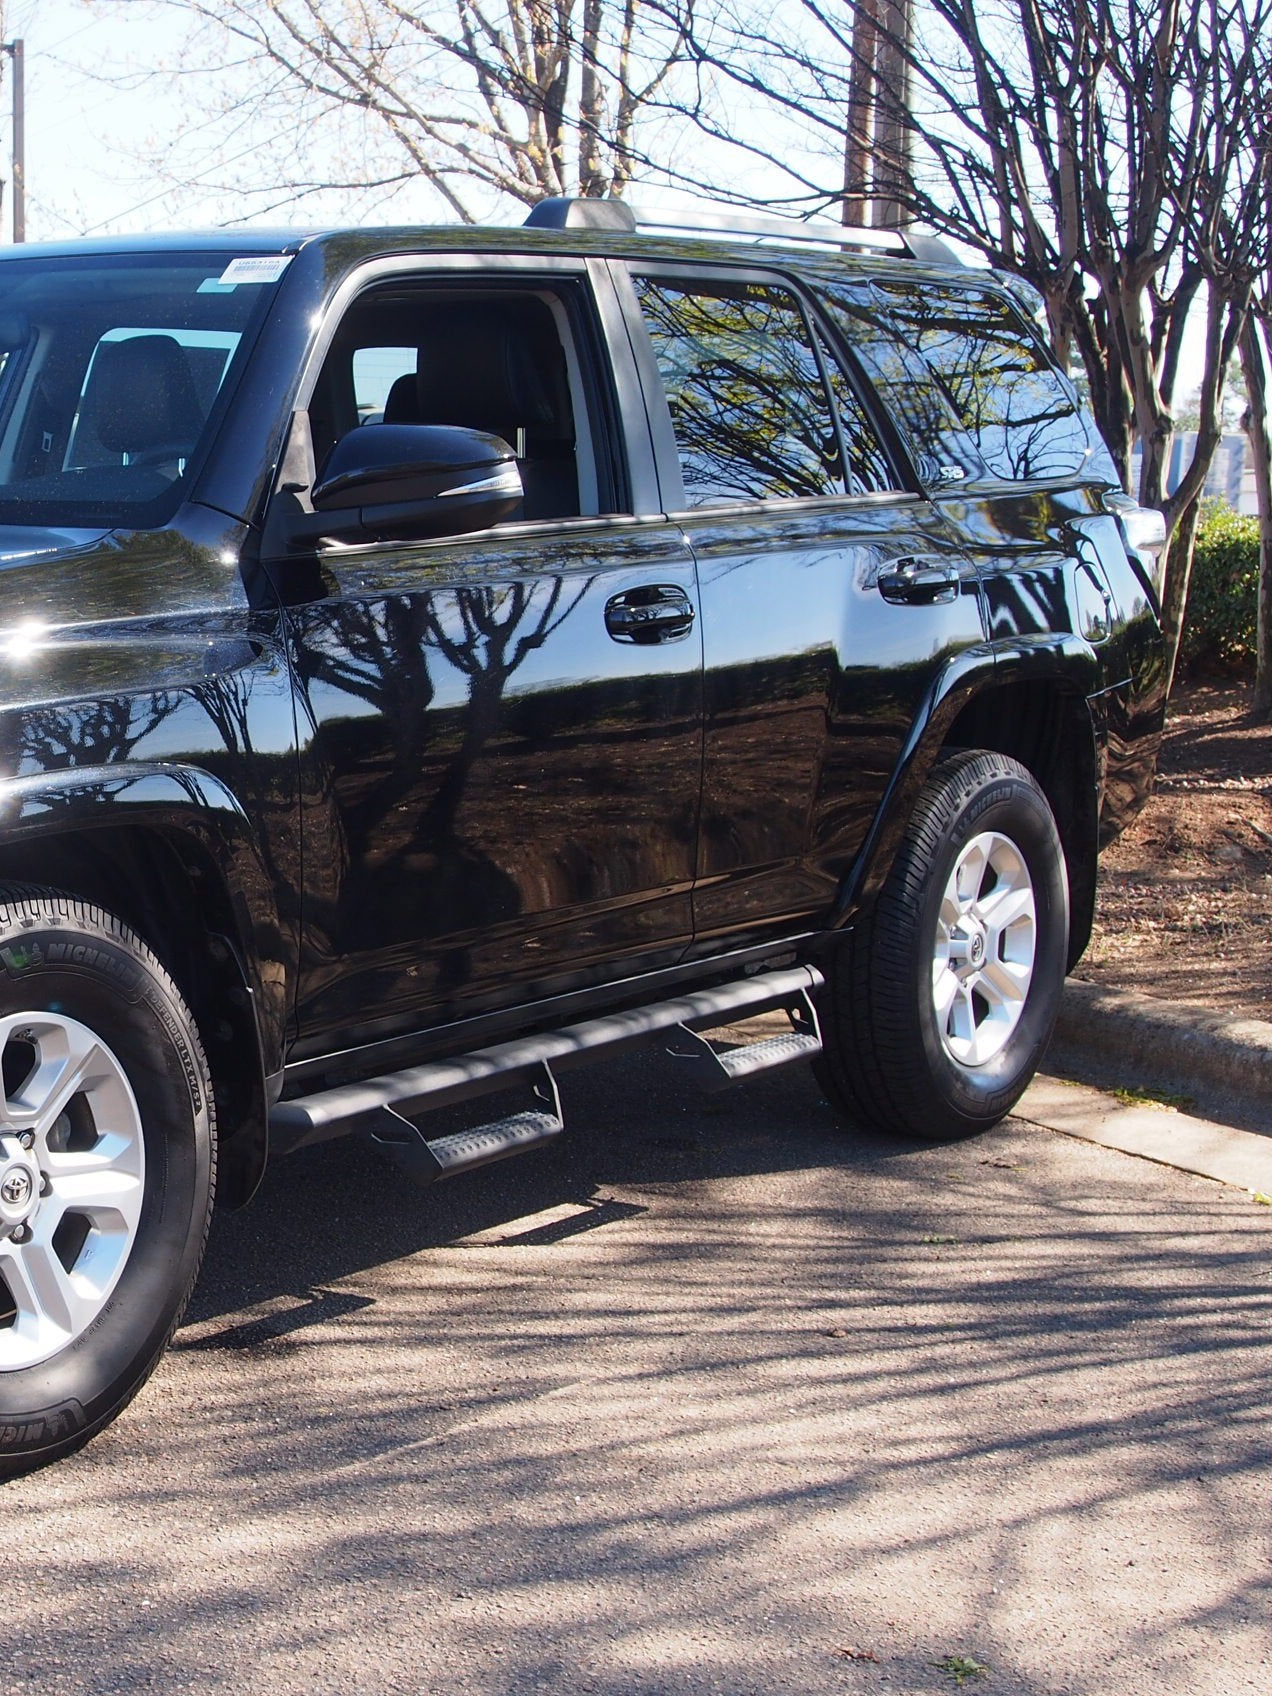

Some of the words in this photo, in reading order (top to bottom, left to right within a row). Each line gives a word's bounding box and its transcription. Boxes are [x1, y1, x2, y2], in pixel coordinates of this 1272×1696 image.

[47, 943, 140, 986] MICHELIN
[150, 993, 184, 1048] DEFENDER
[181, 1048, 194, 1073] LTX
